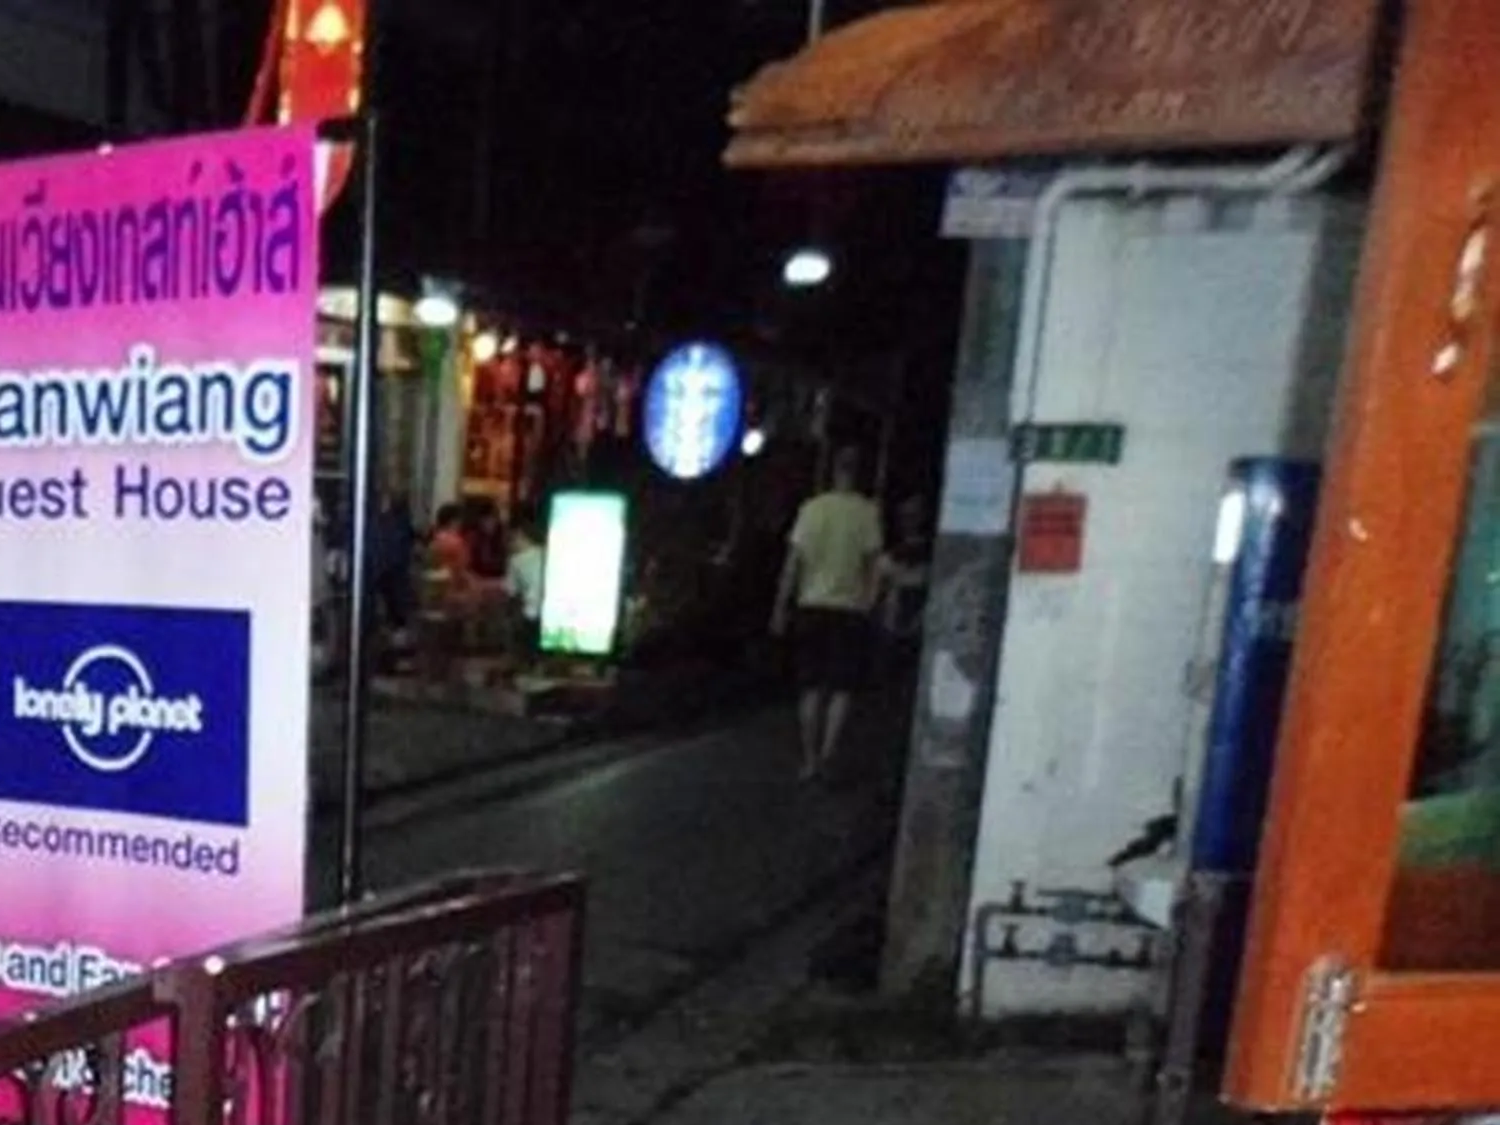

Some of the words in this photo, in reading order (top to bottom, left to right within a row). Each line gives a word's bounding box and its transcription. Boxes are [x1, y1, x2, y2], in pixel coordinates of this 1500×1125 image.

[114, 465, 292, 521] House
[13, 676, 104, 736] lonely
[108, 684, 202, 735] planet
[8, 950, 68, 990] and
[78, 953, 141, 992] Fa
